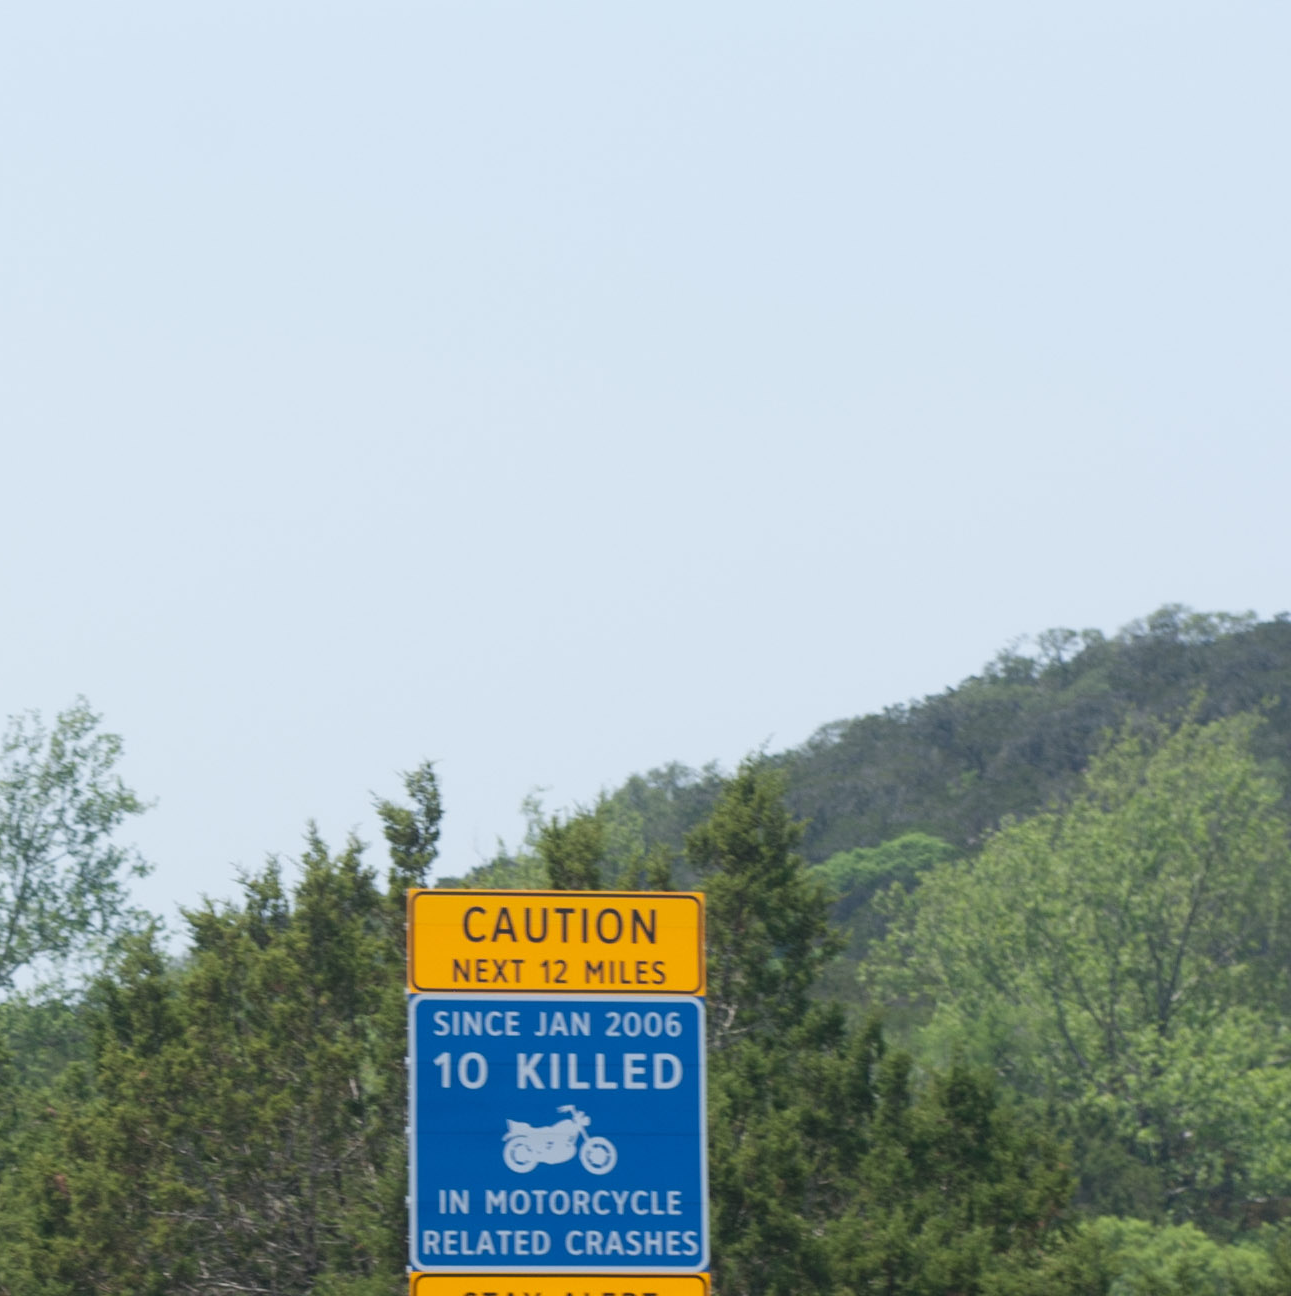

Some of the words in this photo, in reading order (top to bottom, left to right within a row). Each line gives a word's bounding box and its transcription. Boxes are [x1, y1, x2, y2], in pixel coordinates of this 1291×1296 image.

[463, 906, 657, 944] CAUTION
[452, 959, 525, 983] NEXT
[540, 960, 567, 984] 12
[585, 960, 667, 985] MILES
[433, 1011, 521, 1036] SINCE
[534, 1012, 591, 1037] JAN
[605, 1012, 683, 1037] 2006
[433, 1052, 489, 1089] 10
[516, 1053, 683, 1090] KILLED
[438, 1189, 469, 1214] IN
[485, 1189, 683, 1216] MOTORCYCLE
[422, 1230, 552, 1255] RELATED
[565, 1230, 699, 1256] CRASHES
